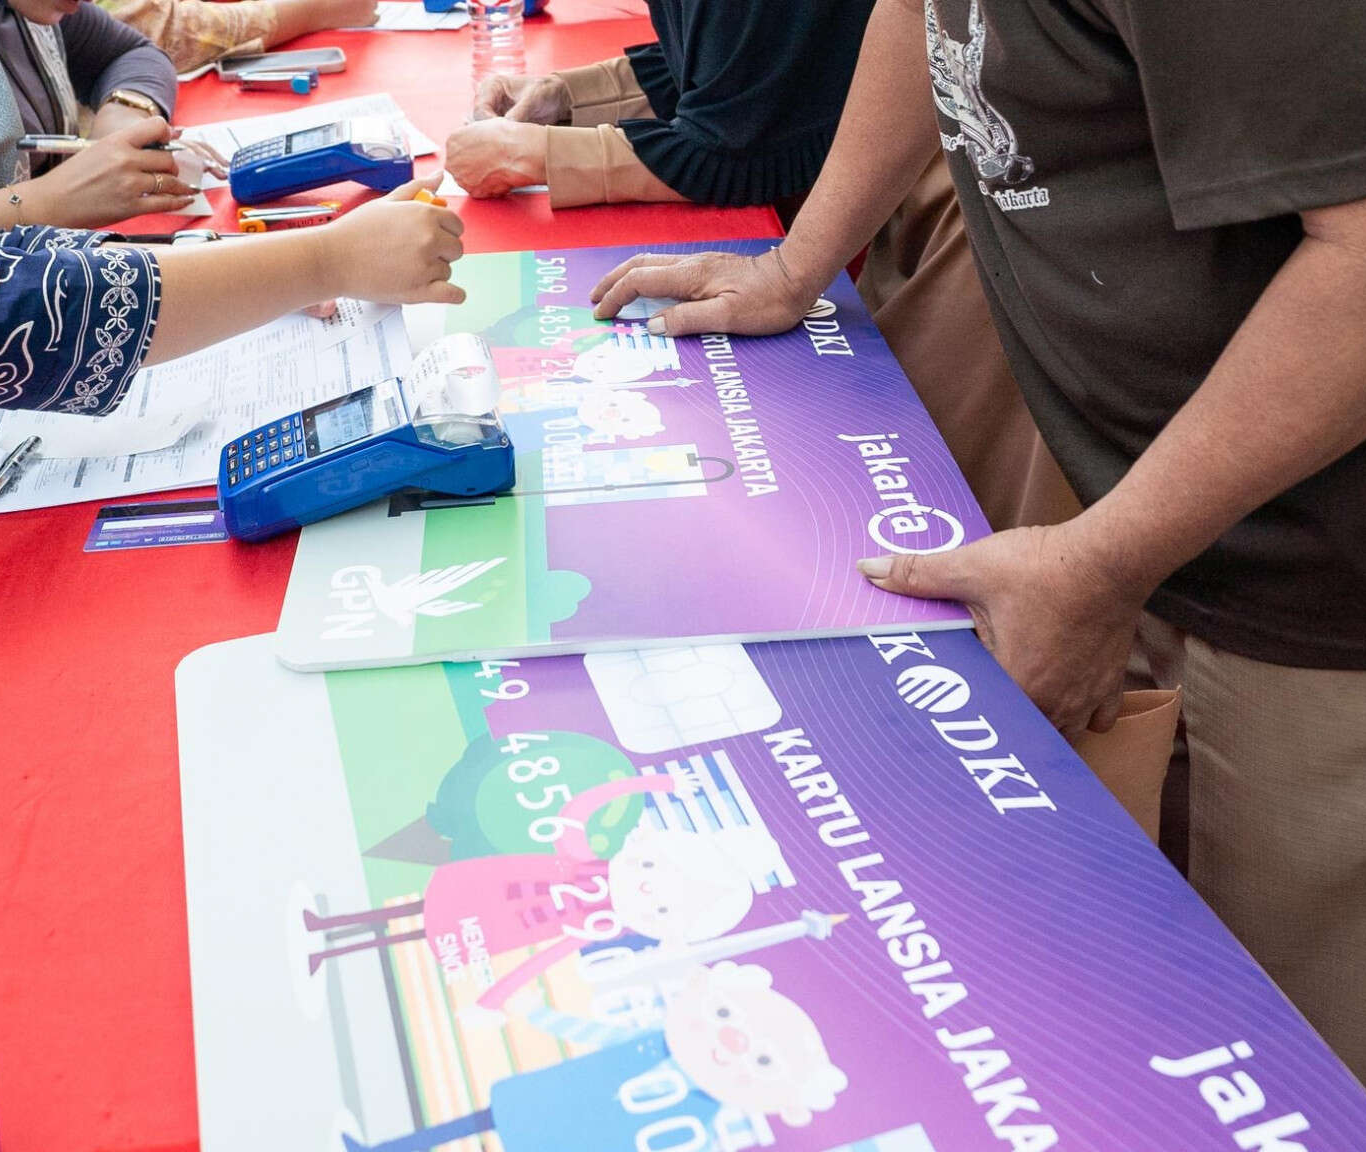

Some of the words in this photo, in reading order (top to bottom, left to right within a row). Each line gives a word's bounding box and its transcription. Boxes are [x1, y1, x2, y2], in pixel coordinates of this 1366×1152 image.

[535, 257, 568, 295] 5049
[538, 304, 573, 348] 4856
[701, 334, 735, 360] RTU
[802, 319, 854, 357] DKI
[709, 363, 752, 415] LANSIA
[725, 418, 780, 497] JAKARTA
[837, 433, 929, 535] jakarta
[319, 564, 382, 640] GPN
[500, 732, 585, 844] 4856
[931, 715, 1057, 815] DKI
[763, 728, 870, 848] KARTU
[837, 853, 968, 1019] LANSIA
